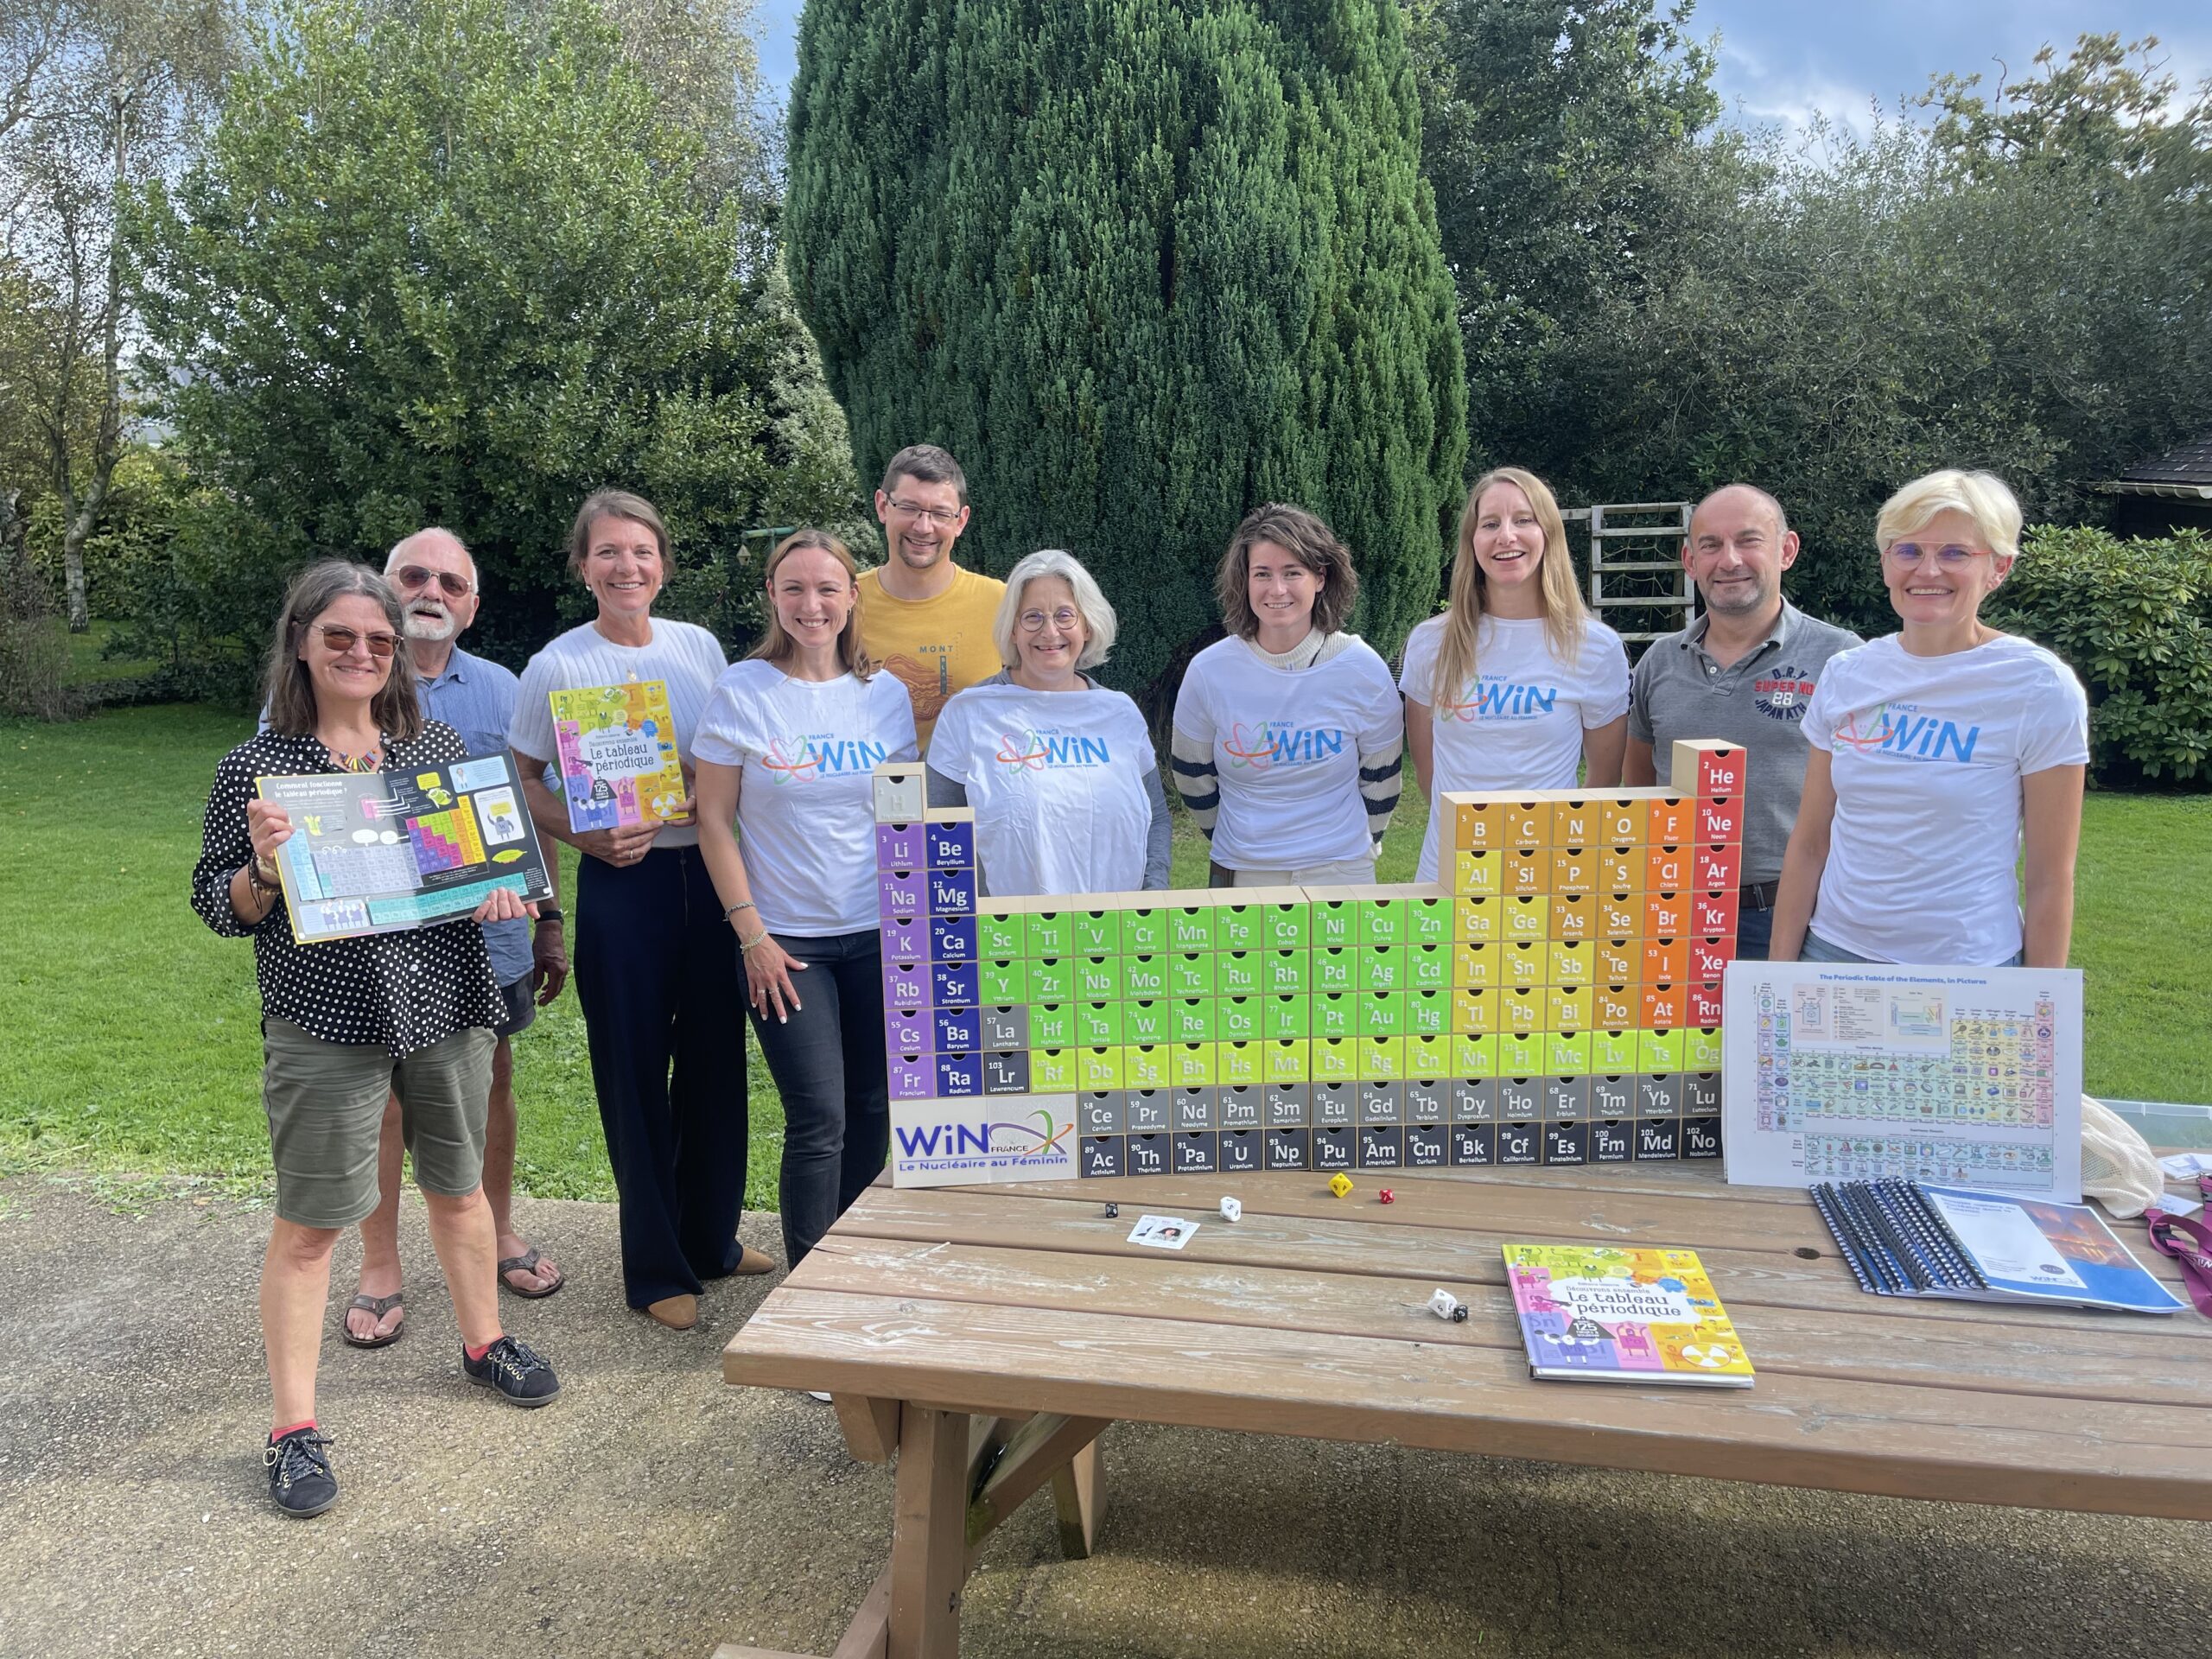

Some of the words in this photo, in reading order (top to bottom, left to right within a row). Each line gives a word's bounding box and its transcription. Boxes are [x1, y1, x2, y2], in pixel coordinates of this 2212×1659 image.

[920, 645, 953, 653] MONT
[1755, 680, 1796, 692] SUPER
[1772, 692, 1794, 705] 28
[1755, 699, 1783, 720] JAPAN
[1888, 702, 1918, 712] FRANCE
[590, 748, 602, 760] Le
[606, 744, 647, 758] tableau
[595, 756, 654, 775] périodique
[1711, 769, 1733, 784] He
[1475, 823, 1485, 836] B
[1522, 821, 1534, 836] C
[1618, 818, 1631, 833] O
[1668, 817, 1676, 832] F
[1707, 817, 1732, 831] Ne
[895, 842, 907, 857] Li
[939, 842, 961, 855] Be
[1470, 868, 1488, 883] Al
[1519, 868, 1534, 882] Si
[1570, 867, 1580, 881] P
[1618, 866, 1627, 880] S
[1707, 863, 1727, 878] Ar
[892, 891, 915, 905] Na
[938, 888, 967, 906] Mg
[1562, 913, 1583, 928] As
[1659, 911, 1677, 925] Br
[1707, 910, 1725, 924] Kr
[1230, 924, 1249, 938] Fe
[1275, 923, 1298, 937] Co
[1327, 918, 1344, 933] Ni
[1372, 918, 1394, 933] Cu
[1421, 918, 1441, 931] Zn
[900, 937, 912, 950] K
[944, 935, 964, 949] Ca
[993, 933, 1011, 947] Sc
[1042, 930, 1058, 945] Ti
[1419, 962, 1440, 977] Cd
[1609, 958, 1628, 972] Te
[1701, 956, 1723, 970] Xe
[1371, 964, 1394, 981] Ag
[1132, 973, 1160, 987] Mo
[947, 981, 964, 995] Sr
[1700, 1001, 1720, 1015] Rn
[1281, 1013, 1293, 1027] Ir
[1327, 1011, 1344, 1025] Pt
[1370, 1010, 1393, 1024] Au
[1417, 1009, 1440, 1027] Hg
[997, 1025, 1014, 1038] La
[1137, 1018, 1156, 1033] W
[900, 1028, 919, 1042] Cs
[947, 1027, 968, 1040] Ba
[905, 1074, 920, 1087] Fr
[949, 1071, 969, 1085] Ra
[1000, 1070, 1014, 1083] Lr
[1510, 1096, 1532, 1109] Ho
[1559, 1095, 1575, 1108] Er
[1697, 1090, 1714, 1104] Lu
[1184, 1104, 1206, 1119] Nd
[1511, 1139, 1529, 1153] Cf
[1600, 1138, 1624, 1151] Fm
[1692, 1135, 1715, 1148] No
[1138, 1150, 1160, 1165] Th
[1236, 1147, 1247, 1160] U
[1275, 1145, 1299, 1162] Np
[1325, 1145, 1344, 1158] Pu
[899, 1163, 914, 1172] Le
[919, 1160, 986, 1171] Nucléaire
[1013, 1156, 1068, 1166] Féminin
[1092, 1154, 1113, 1166] Ac
[1567, 1292, 1588, 1301] Le
[1594, 1293, 1669, 1305] tableau
[1577, 1303, 1681, 1317] périodique
[1573, 1323, 1598, 1332] 125
